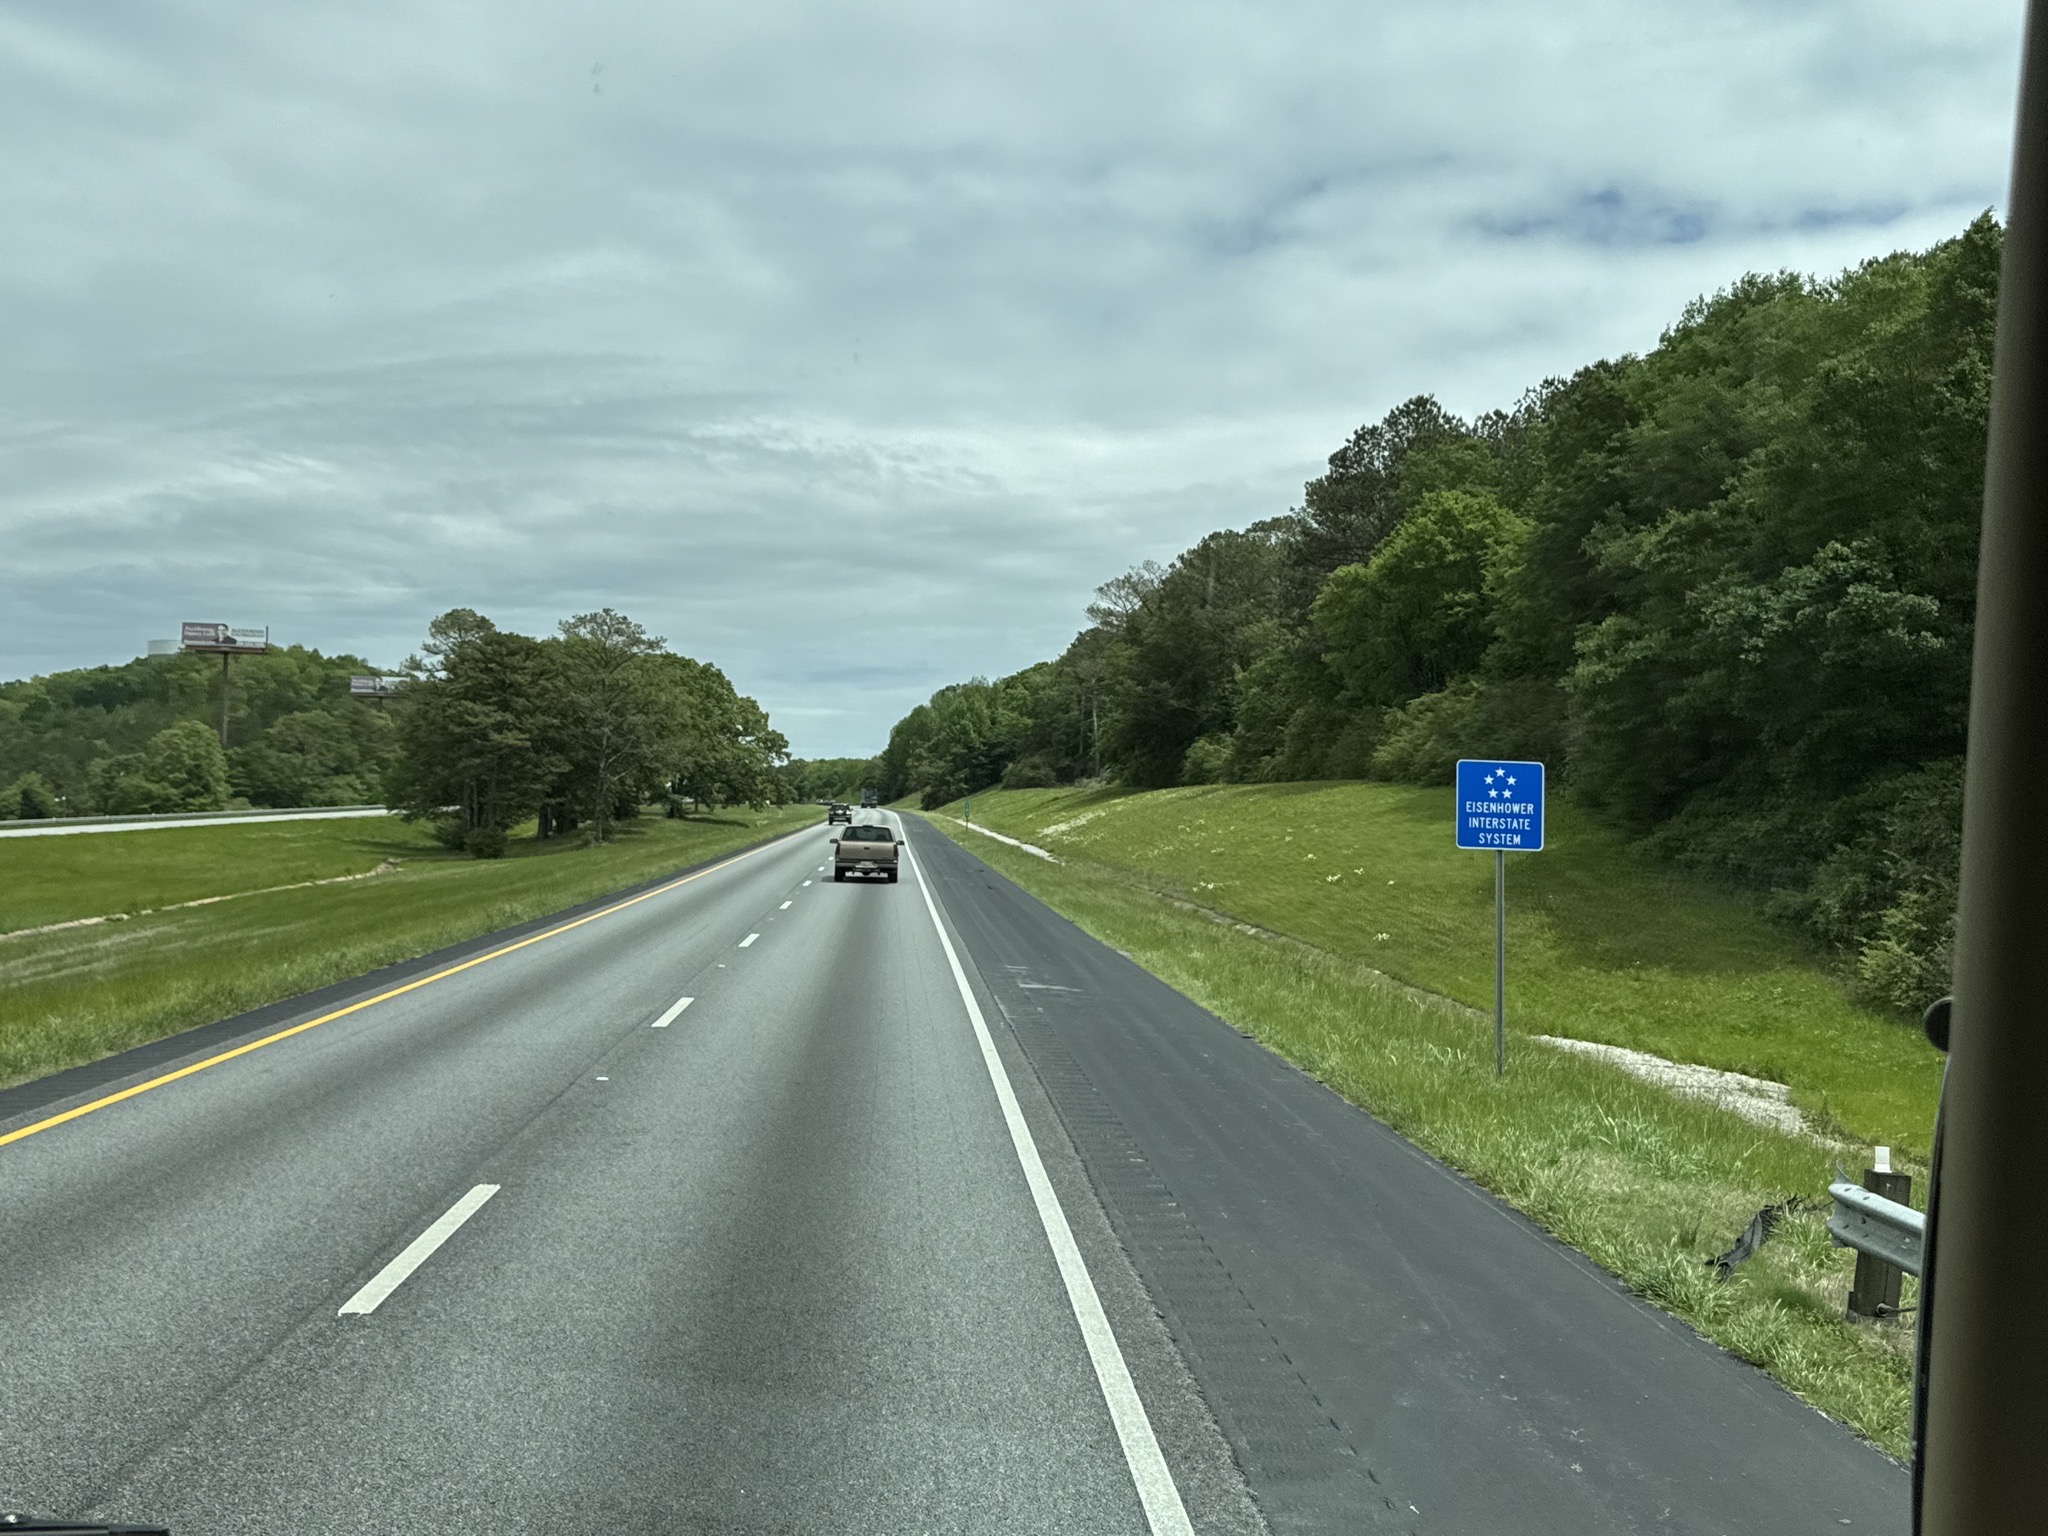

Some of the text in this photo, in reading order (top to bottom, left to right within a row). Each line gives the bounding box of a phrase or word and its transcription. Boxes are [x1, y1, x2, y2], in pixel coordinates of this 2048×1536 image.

[1465, 801, 1534, 815] EISENHOWER
[1468, 817, 1531, 830] INTERSTATE
[1478, 833, 1521, 845] SYSTEM
